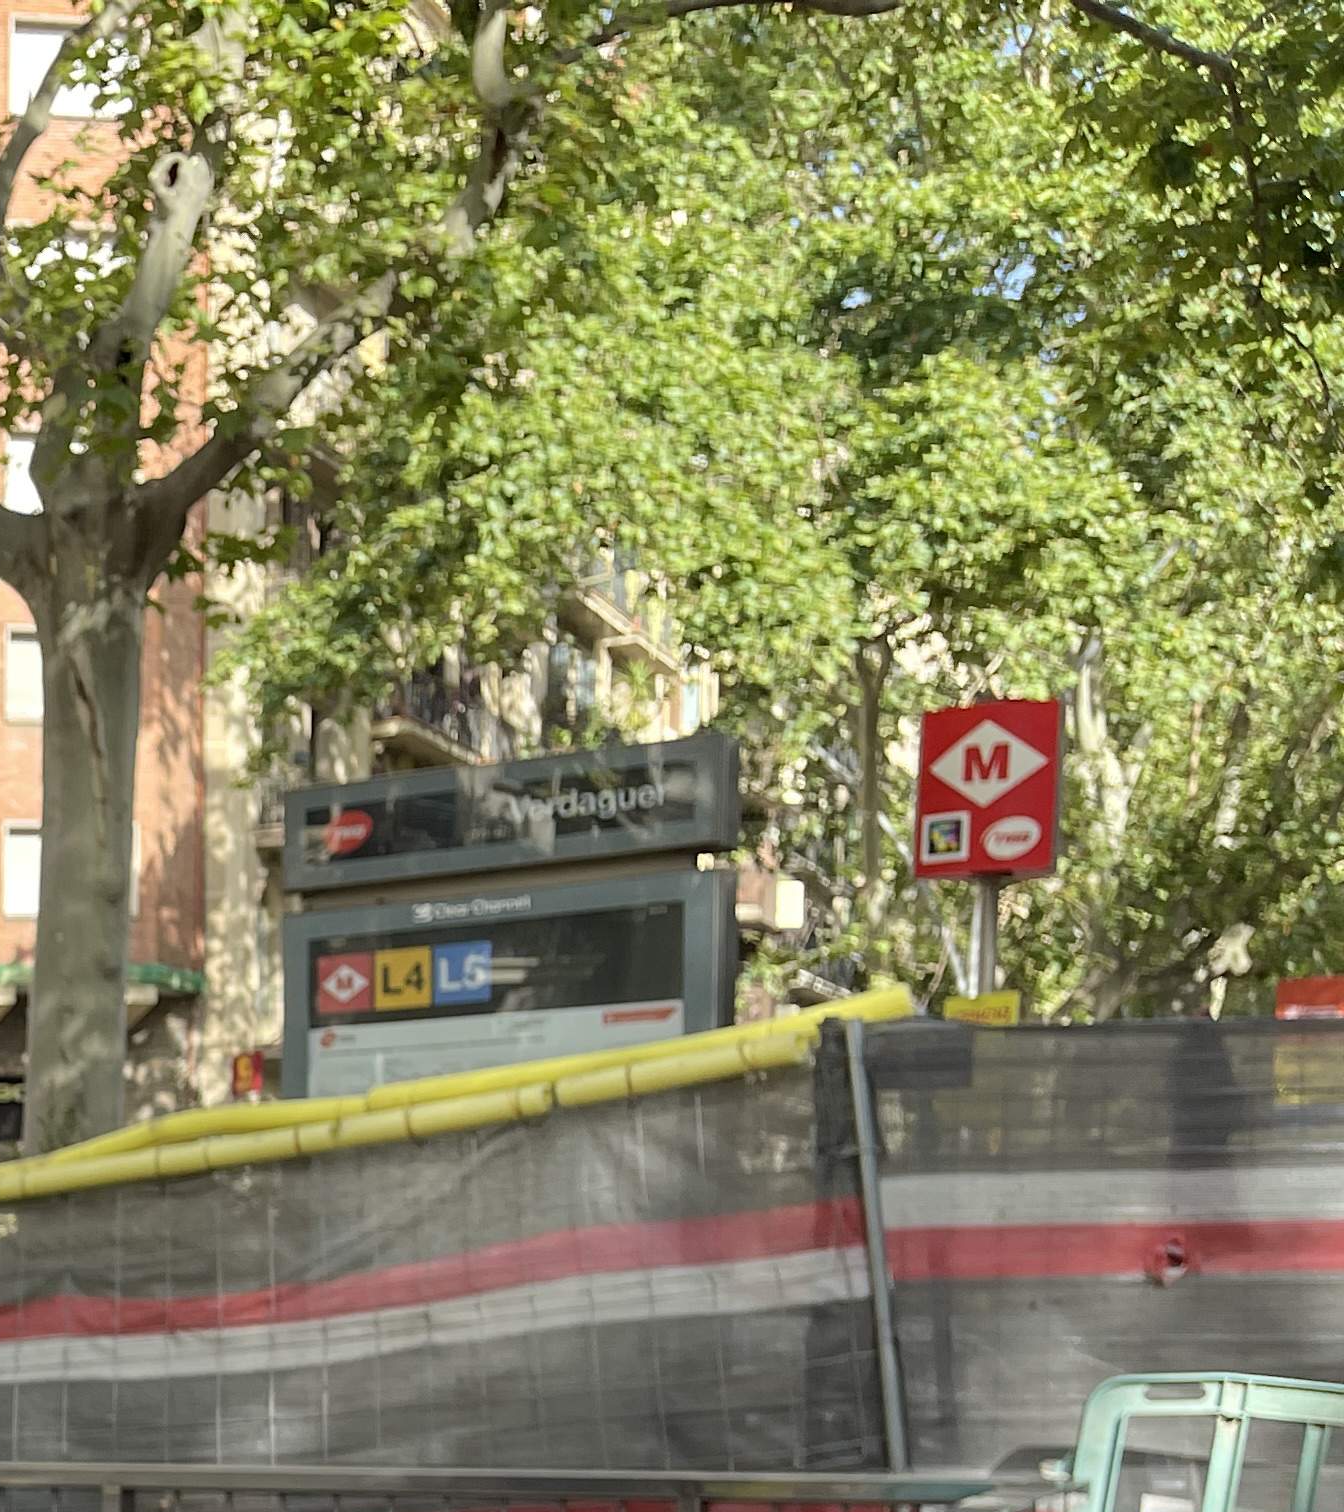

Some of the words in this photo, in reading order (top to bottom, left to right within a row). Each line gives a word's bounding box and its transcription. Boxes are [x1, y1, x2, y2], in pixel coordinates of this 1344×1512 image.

[964, 743, 1010, 782] M
[383, 962, 424, 993] L4
[440, 954, 487, 992] L5
